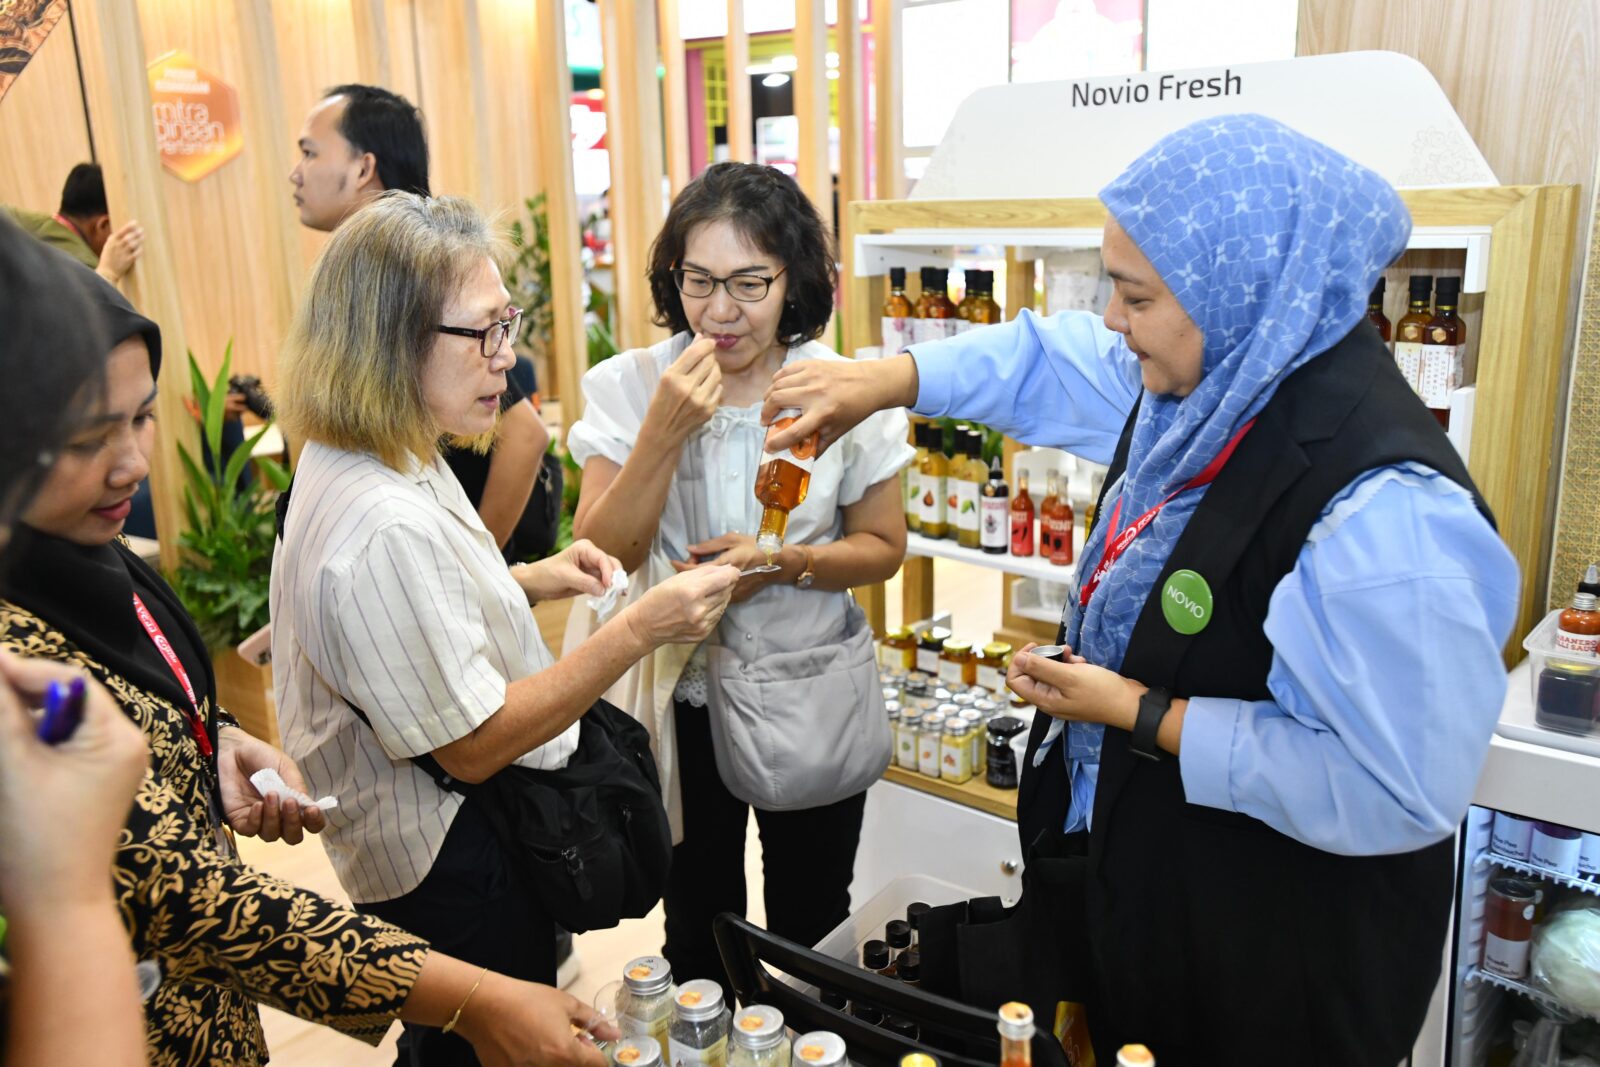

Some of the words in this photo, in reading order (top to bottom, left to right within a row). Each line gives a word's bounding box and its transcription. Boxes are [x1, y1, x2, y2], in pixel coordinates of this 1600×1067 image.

[1072, 78, 1149, 107] Novio
[1159, 69, 1242, 101] Fresh
[1167, 585, 1205, 619] NOVIO
